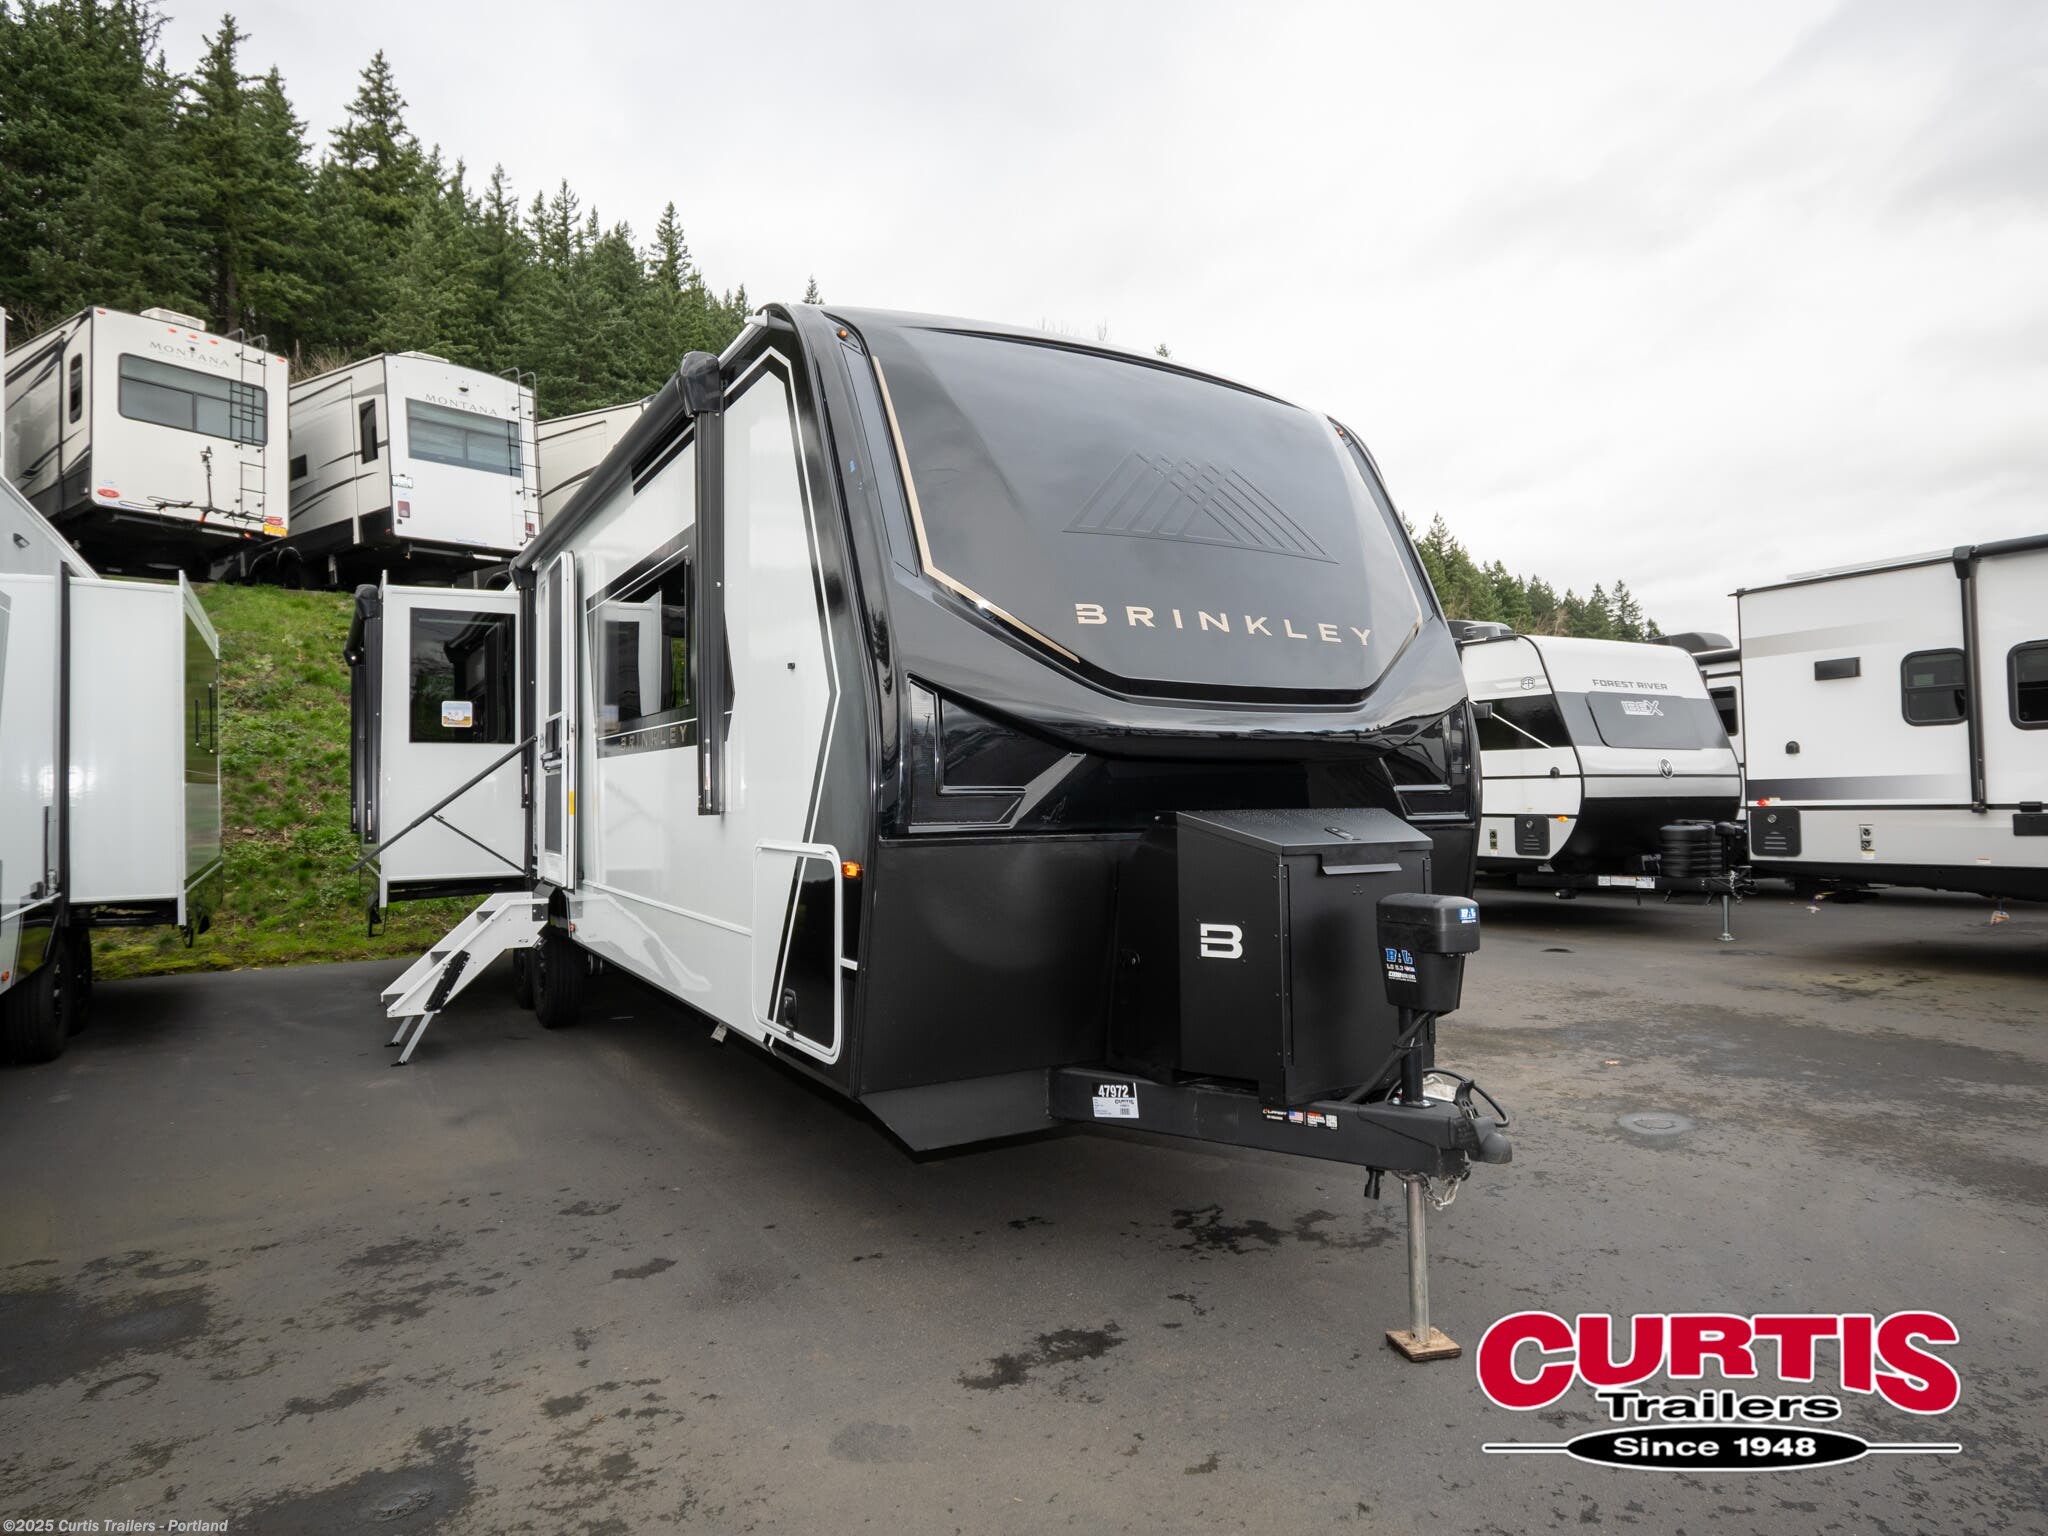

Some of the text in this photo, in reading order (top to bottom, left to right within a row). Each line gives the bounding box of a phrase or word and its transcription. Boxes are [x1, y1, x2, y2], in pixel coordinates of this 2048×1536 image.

[149, 341, 229, 367] MONTANA
[425, 393, 498, 416] MONTANA
[1074, 603, 1371, 646] BRINKLEY
[1592, 679, 1668, 690] FOREST RIVER
[1200, 923, 1243, 959] B
[1098, 1084, 1129, 1098] 47972
